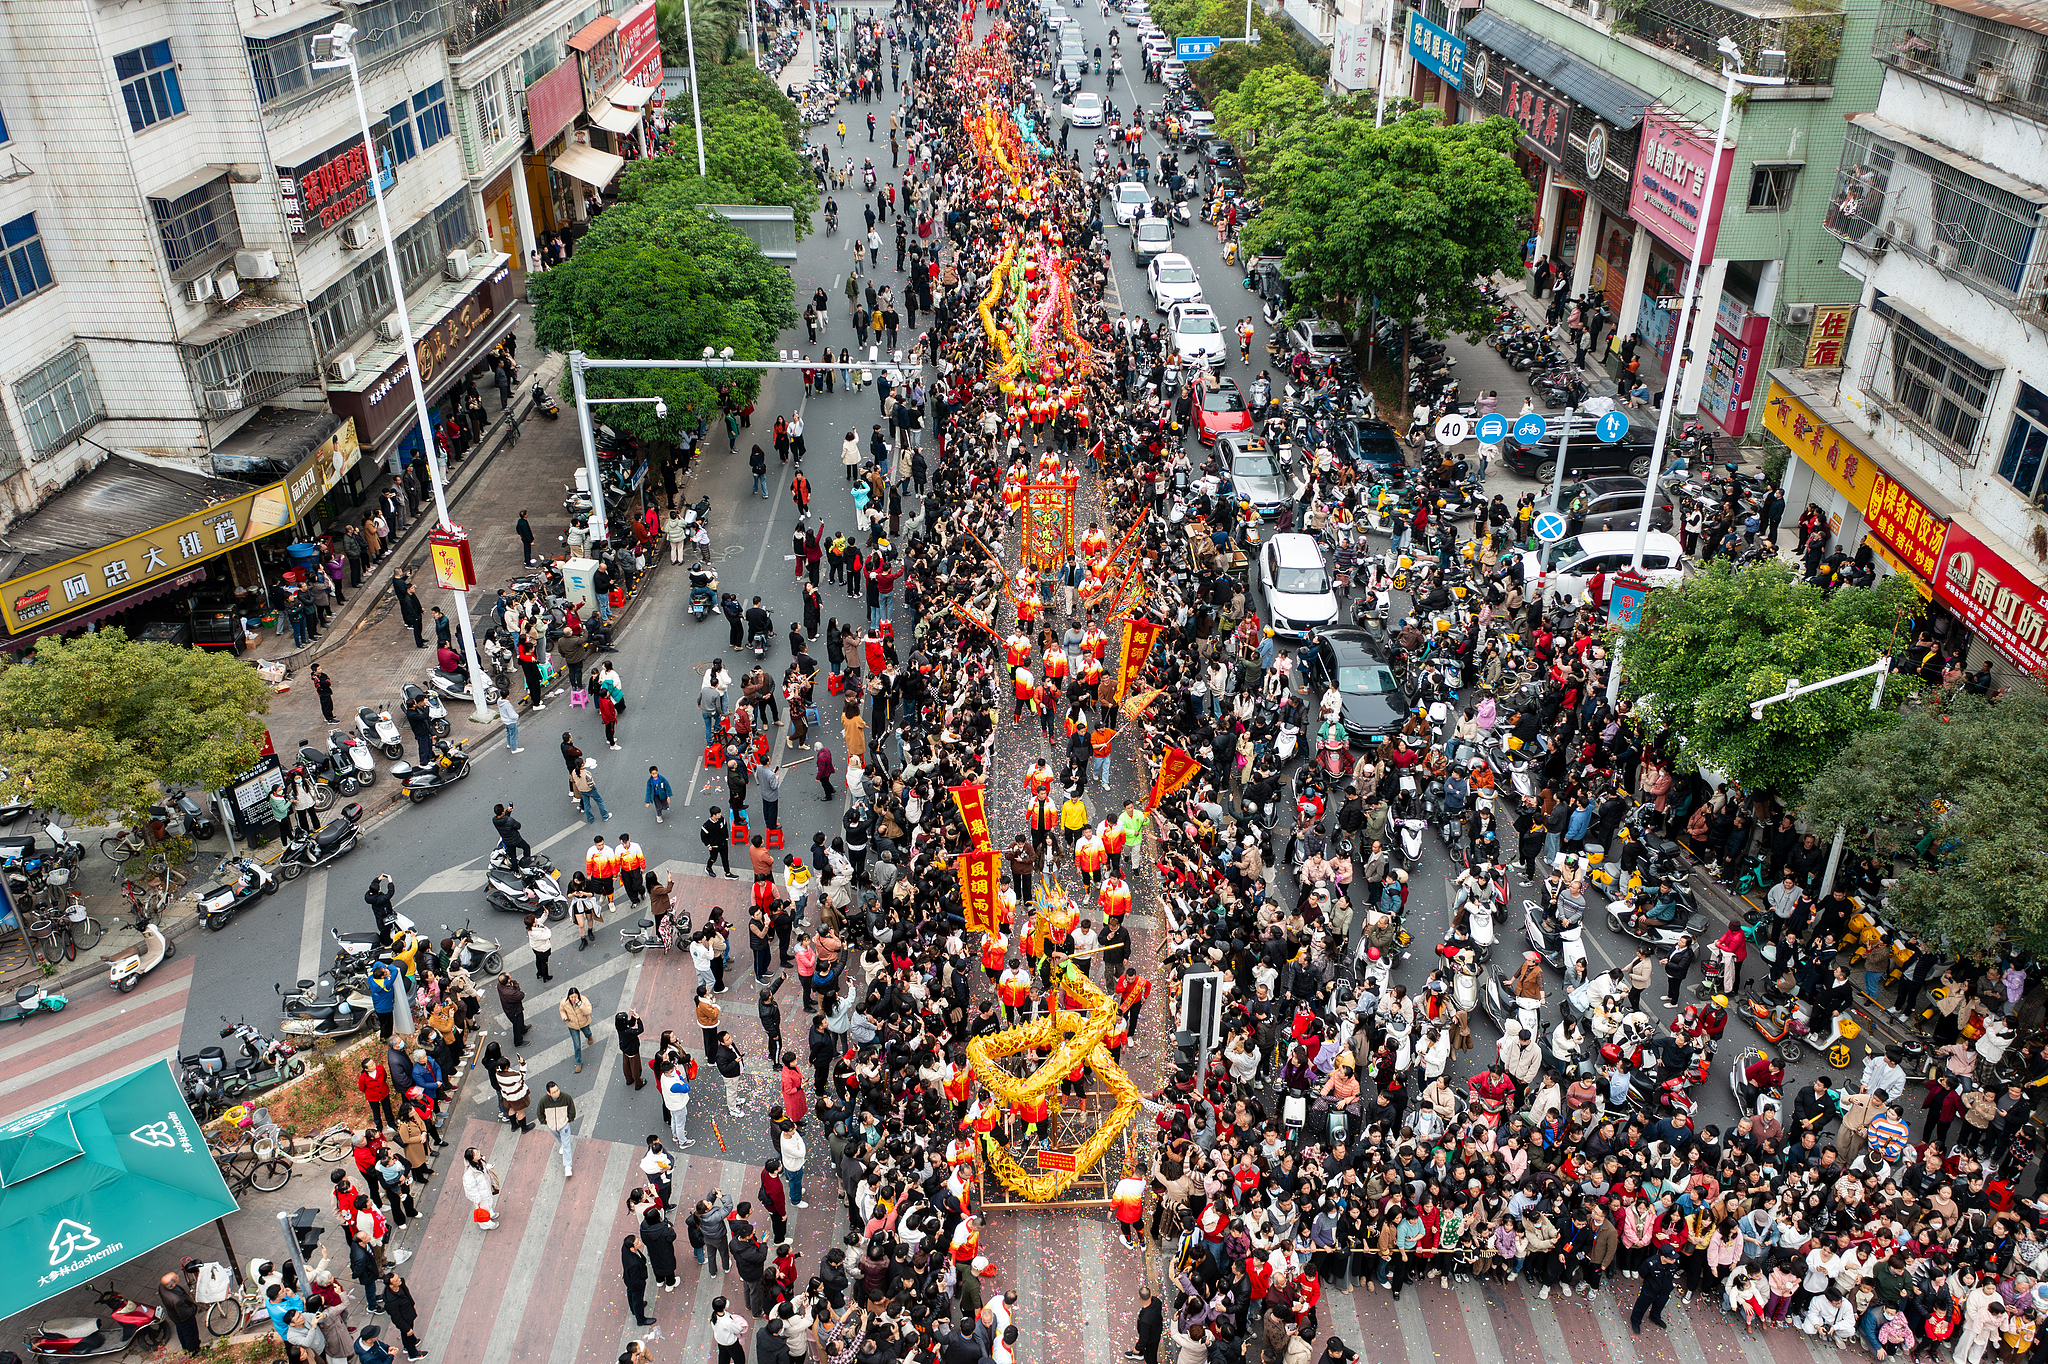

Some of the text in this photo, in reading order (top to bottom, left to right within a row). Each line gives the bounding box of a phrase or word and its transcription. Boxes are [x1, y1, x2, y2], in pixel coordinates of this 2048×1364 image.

[1354, 36, 1368, 78] 艺术家
[1646, 137, 1707, 199] 创新图文广告
[1813, 311, 1846, 364] 住宿
[1441, 423, 1461, 437] 40
[1884, 481, 1945, 557] 粿条面饺汤
[61, 518, 240, 603] 阿忠大排档
[70, 1241, 124, 1273] dashenlin
